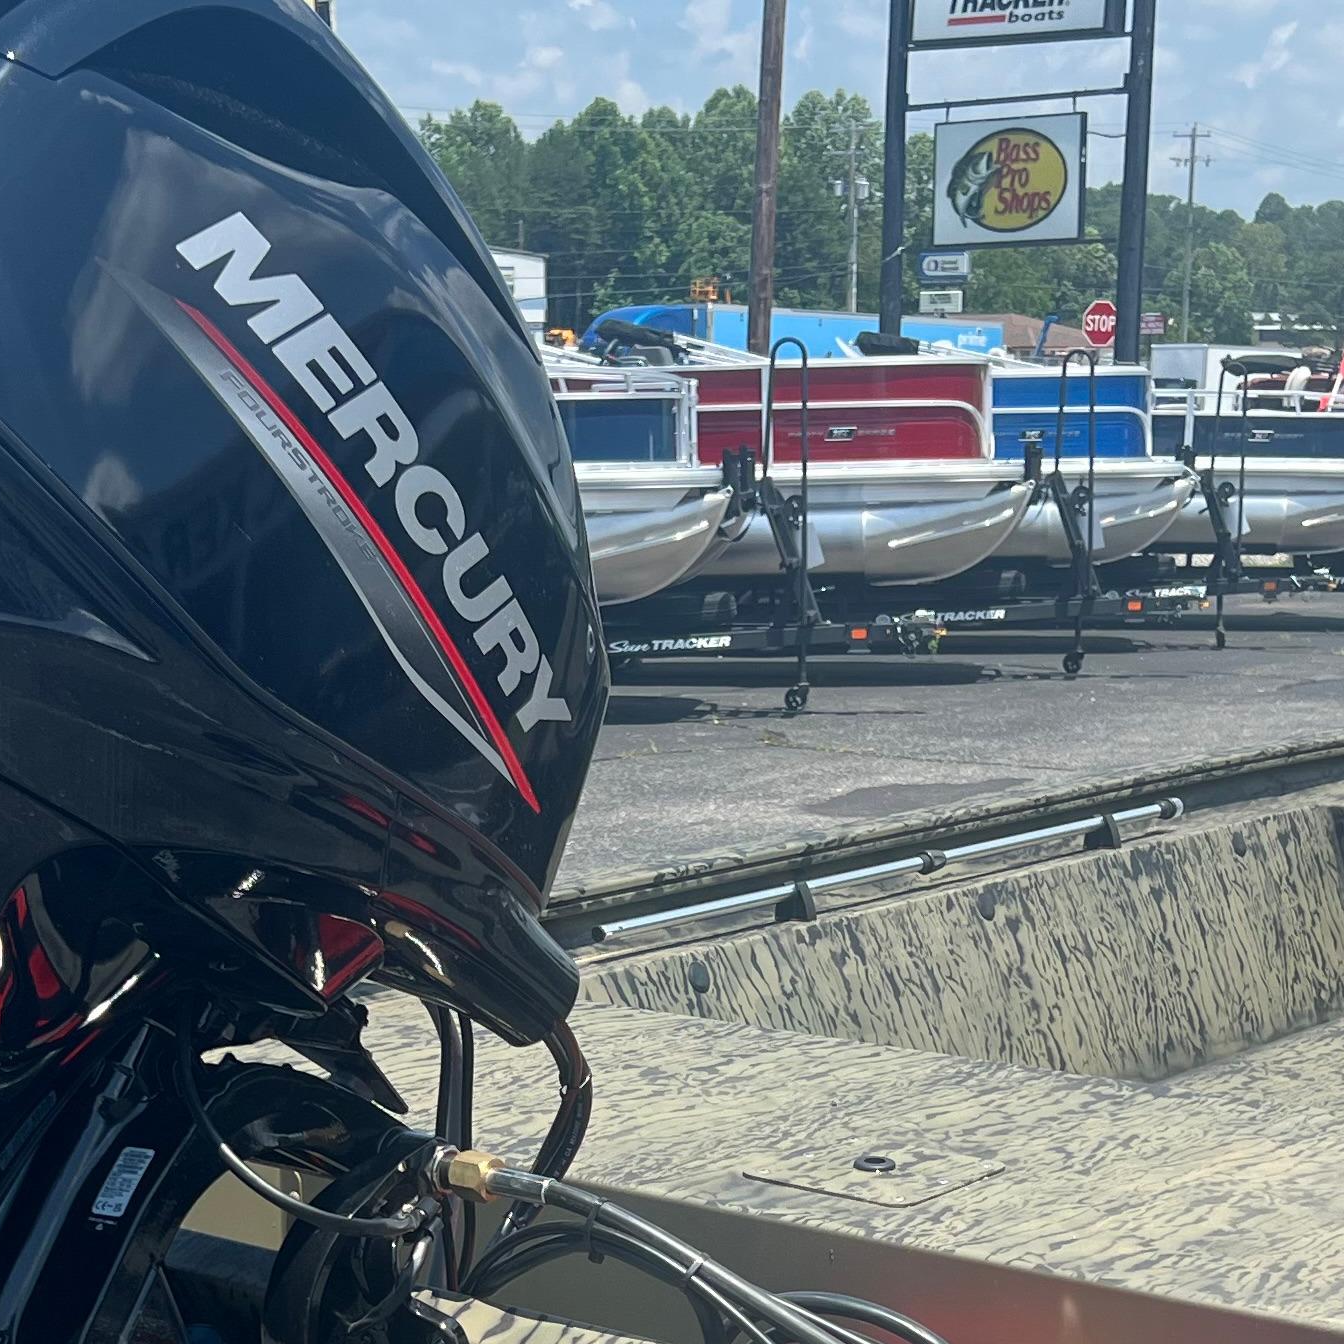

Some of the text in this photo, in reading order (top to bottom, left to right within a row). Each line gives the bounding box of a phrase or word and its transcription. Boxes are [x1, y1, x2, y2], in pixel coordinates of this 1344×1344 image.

[1007, 10, 1064, 23] boats
[996, 137, 1040, 164] Bass
[995, 164, 1029, 189] Pro
[995, 189, 1051, 218] Shops
[1085, 314, 1116, 333] STOP
[176, 212, 572, 733] MERCURY
[217, 367, 376, 562] FOURSTROKE
[937, 609, 1006, 622] TRACKER
[607, 635, 732, 654] Sun TRACKER
